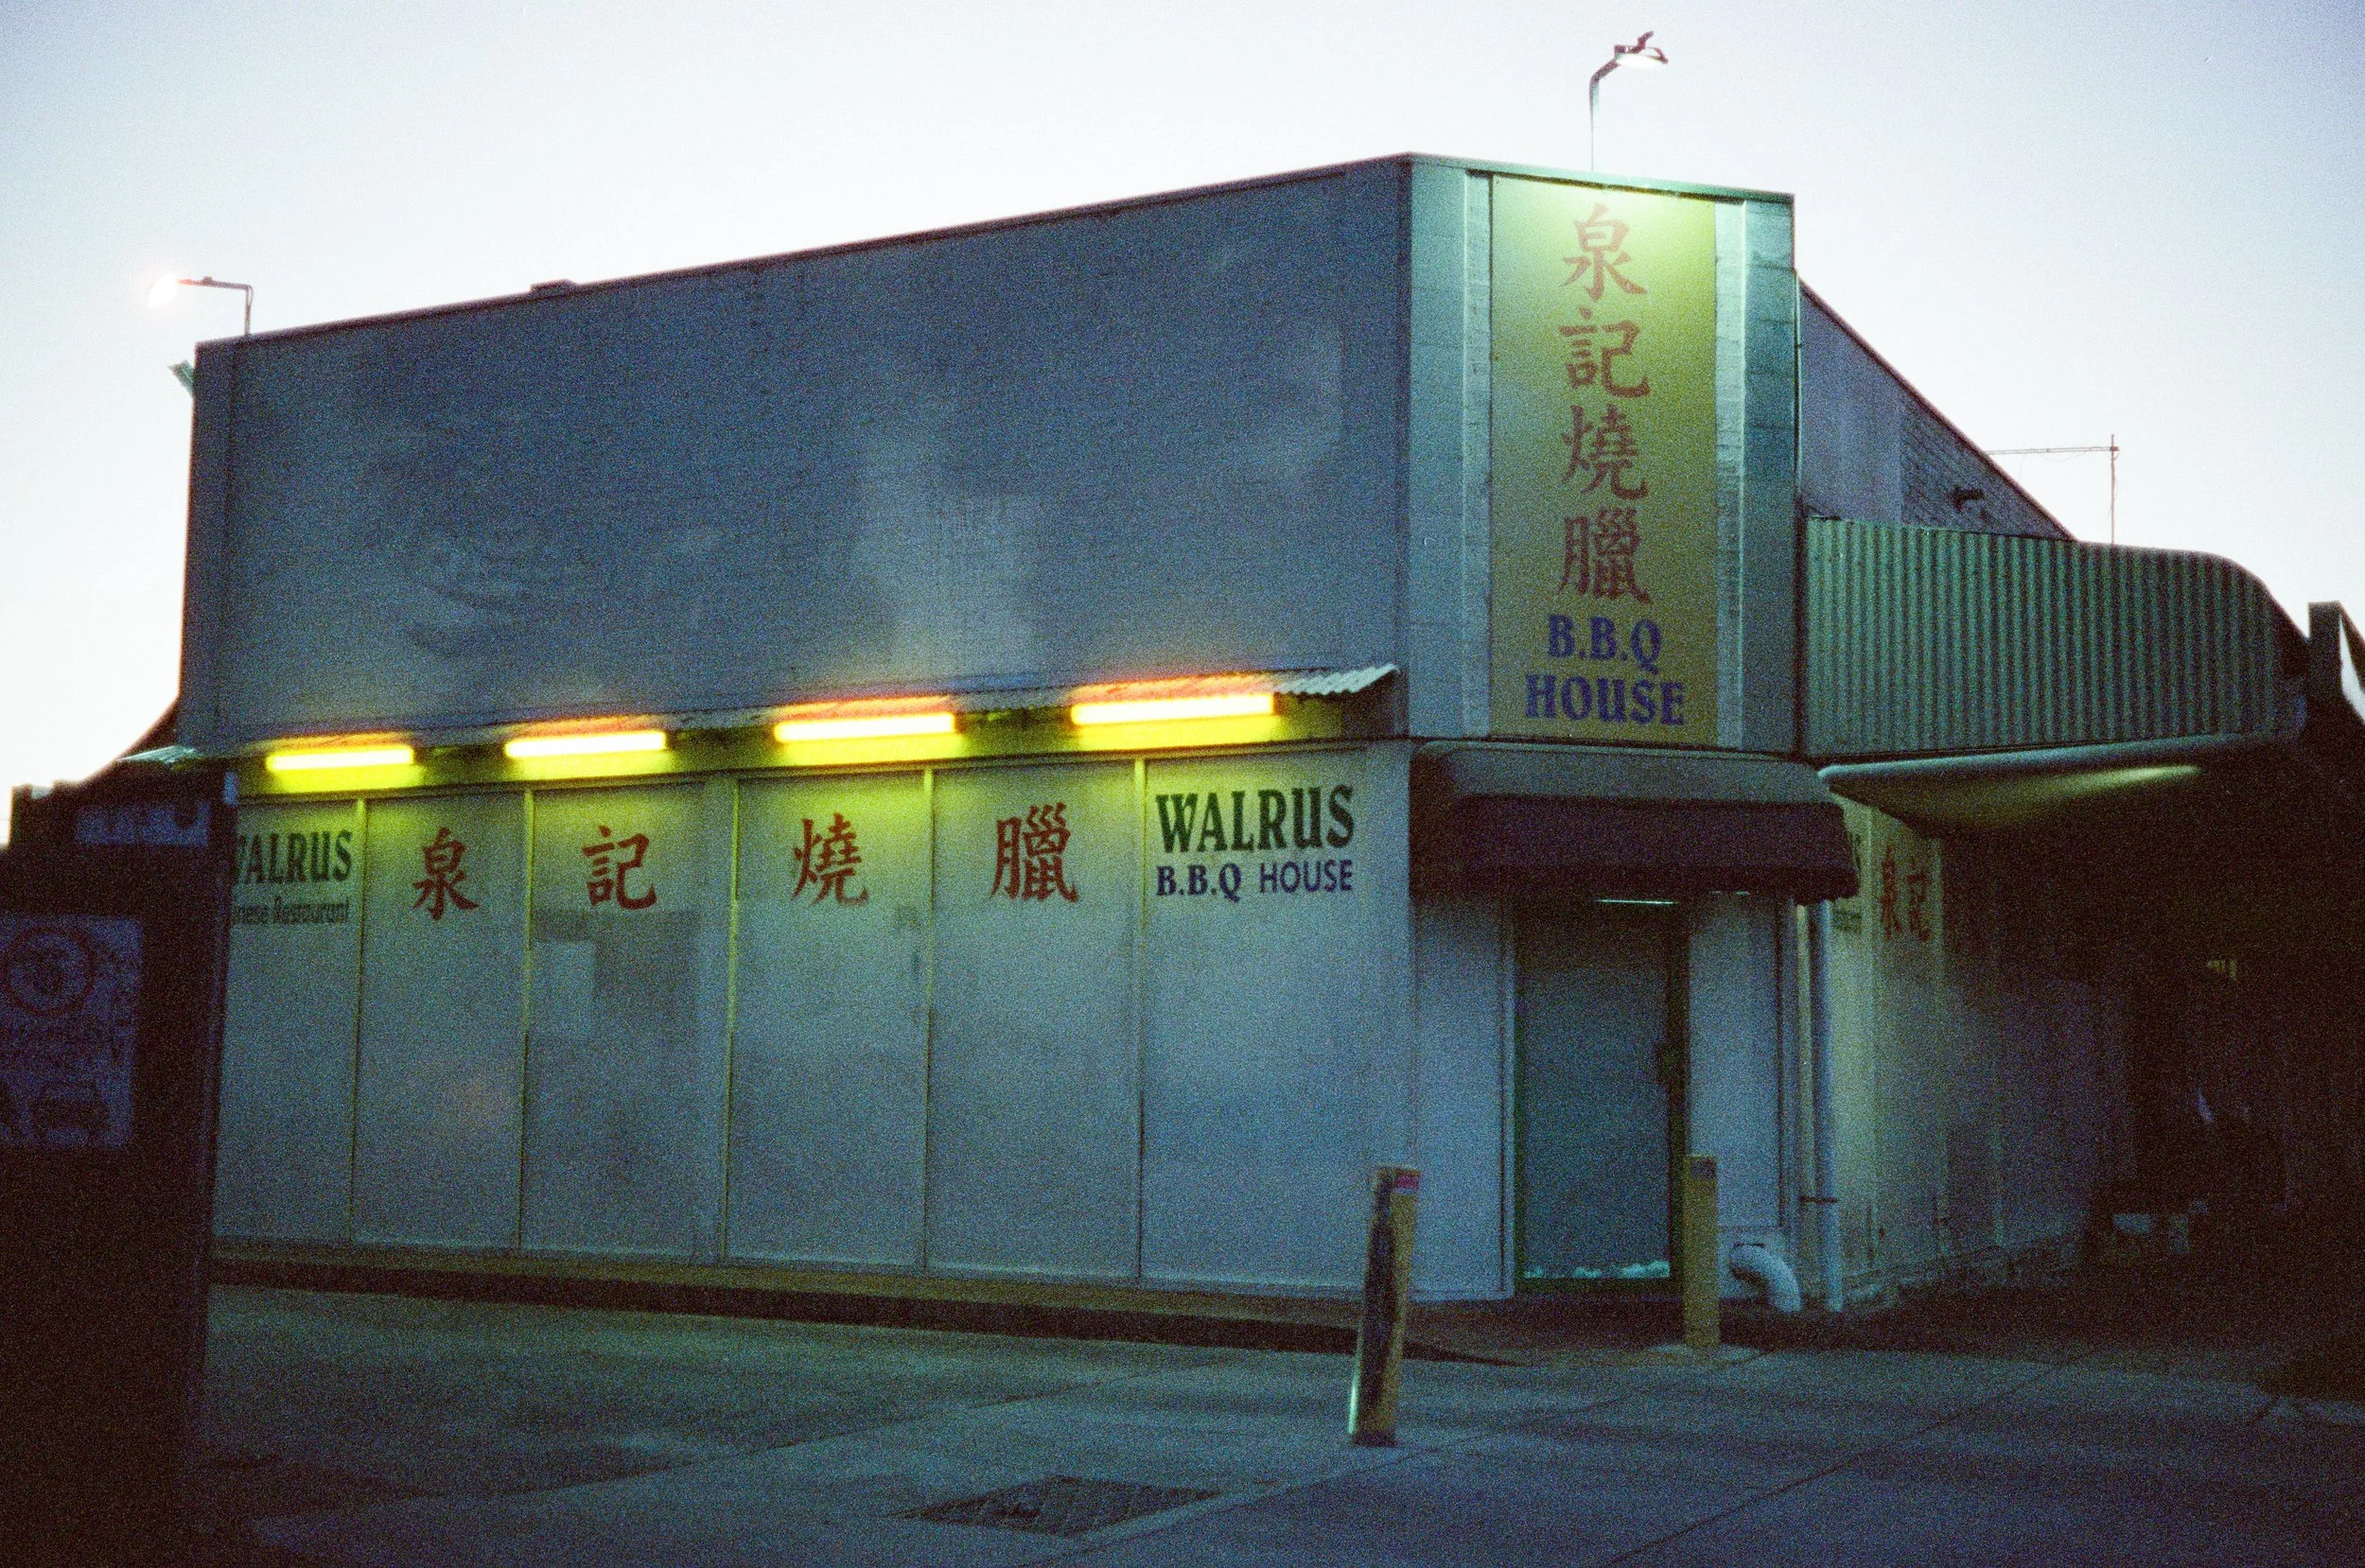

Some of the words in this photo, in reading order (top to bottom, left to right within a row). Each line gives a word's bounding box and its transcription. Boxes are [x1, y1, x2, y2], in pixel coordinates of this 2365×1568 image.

[1548, 614, 1661, 672] B.B.Q
[1526, 674, 1685, 726] HOUSE
[1156, 784, 1354, 852] WALRUS
[1157, 862, 1241, 902] B.B.Q
[1260, 860, 1353, 893] HOUSE
[231, 903, 268, 925] nese
[272, 896, 350, 924] Restaurant
